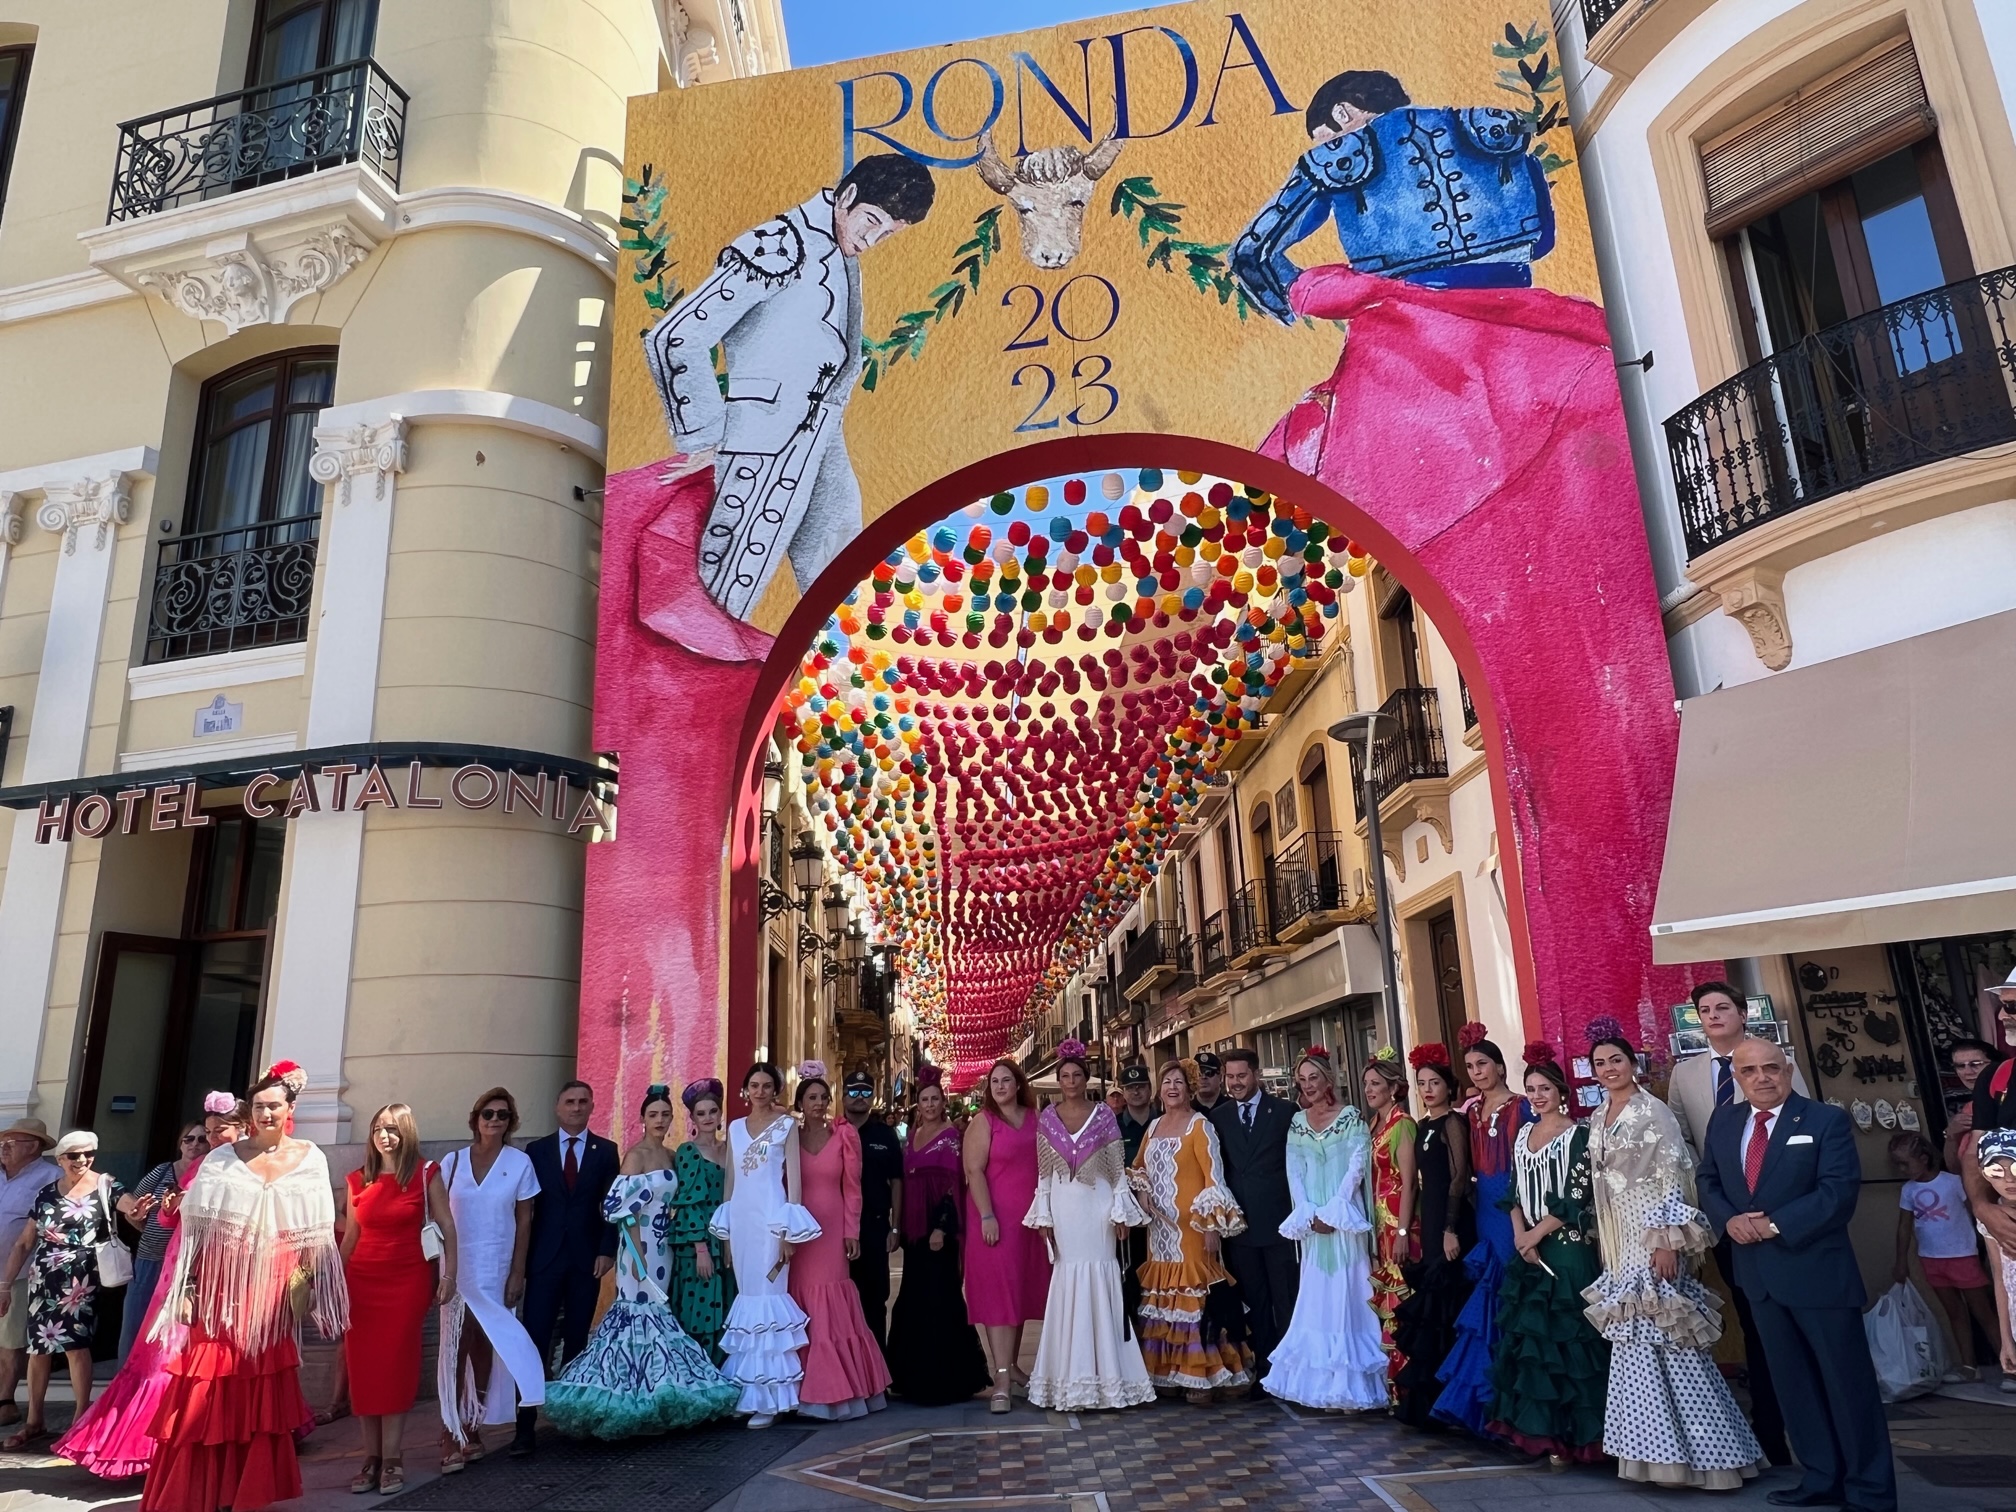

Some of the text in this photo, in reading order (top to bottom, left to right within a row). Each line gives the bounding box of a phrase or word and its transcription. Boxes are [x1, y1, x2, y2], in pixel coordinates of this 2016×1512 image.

[835, 13, 1303, 176] RONDA
[1002, 275, 1120, 351] 20
[1012, 355, 1120, 433] 23
[35, 761, 611, 843] HOTEL CATALONIA
